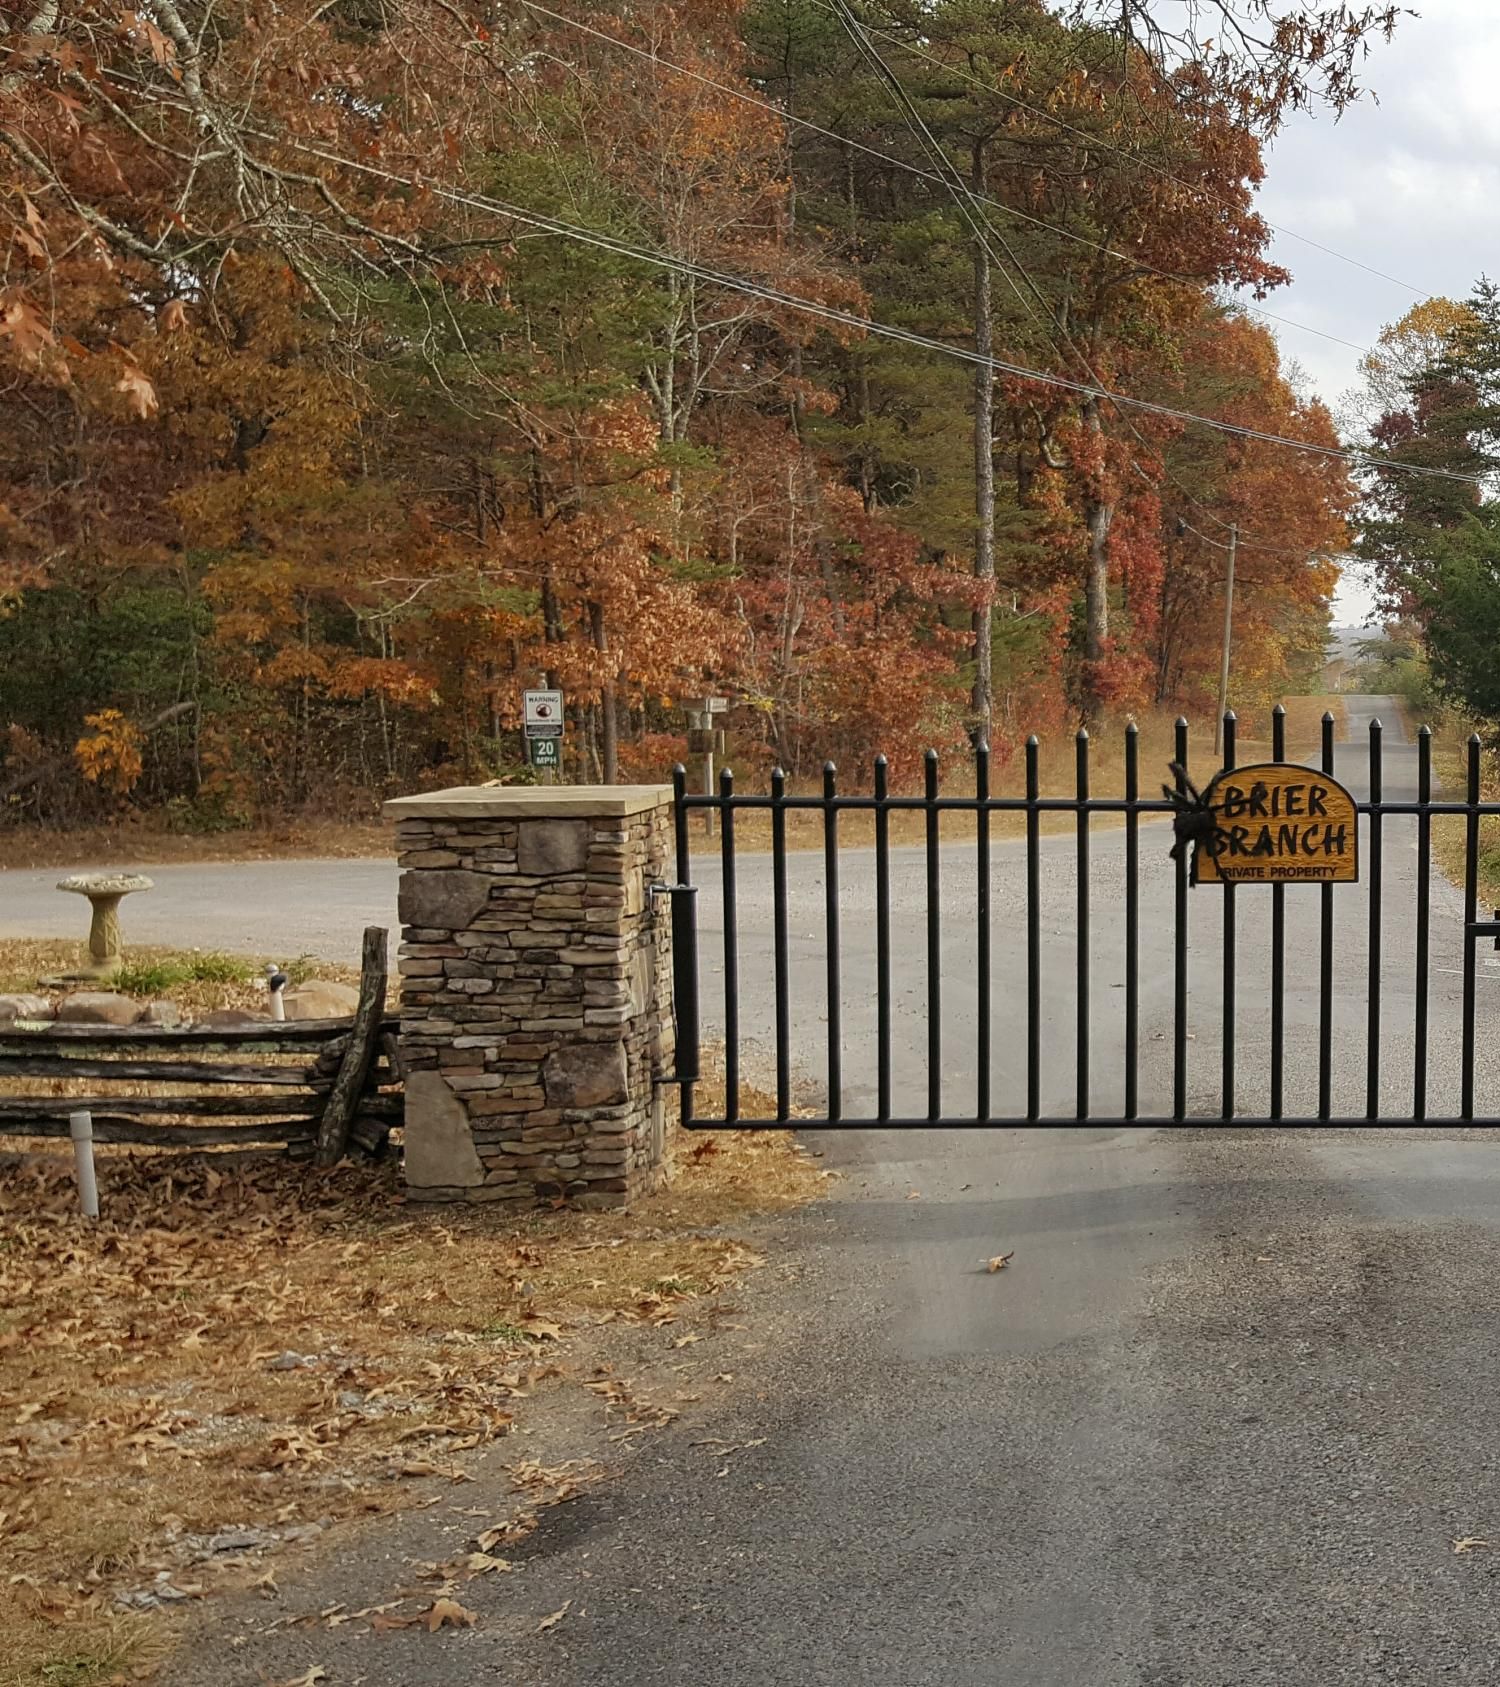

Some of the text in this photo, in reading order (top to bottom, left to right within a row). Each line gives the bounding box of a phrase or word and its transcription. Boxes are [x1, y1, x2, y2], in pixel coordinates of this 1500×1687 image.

[538, 741, 554, 755] 20
[1224, 783, 1328, 817] BRIER
[1205, 823, 1346, 857] BRANCH
[1270, 866, 1337, 877] PROPERTY
